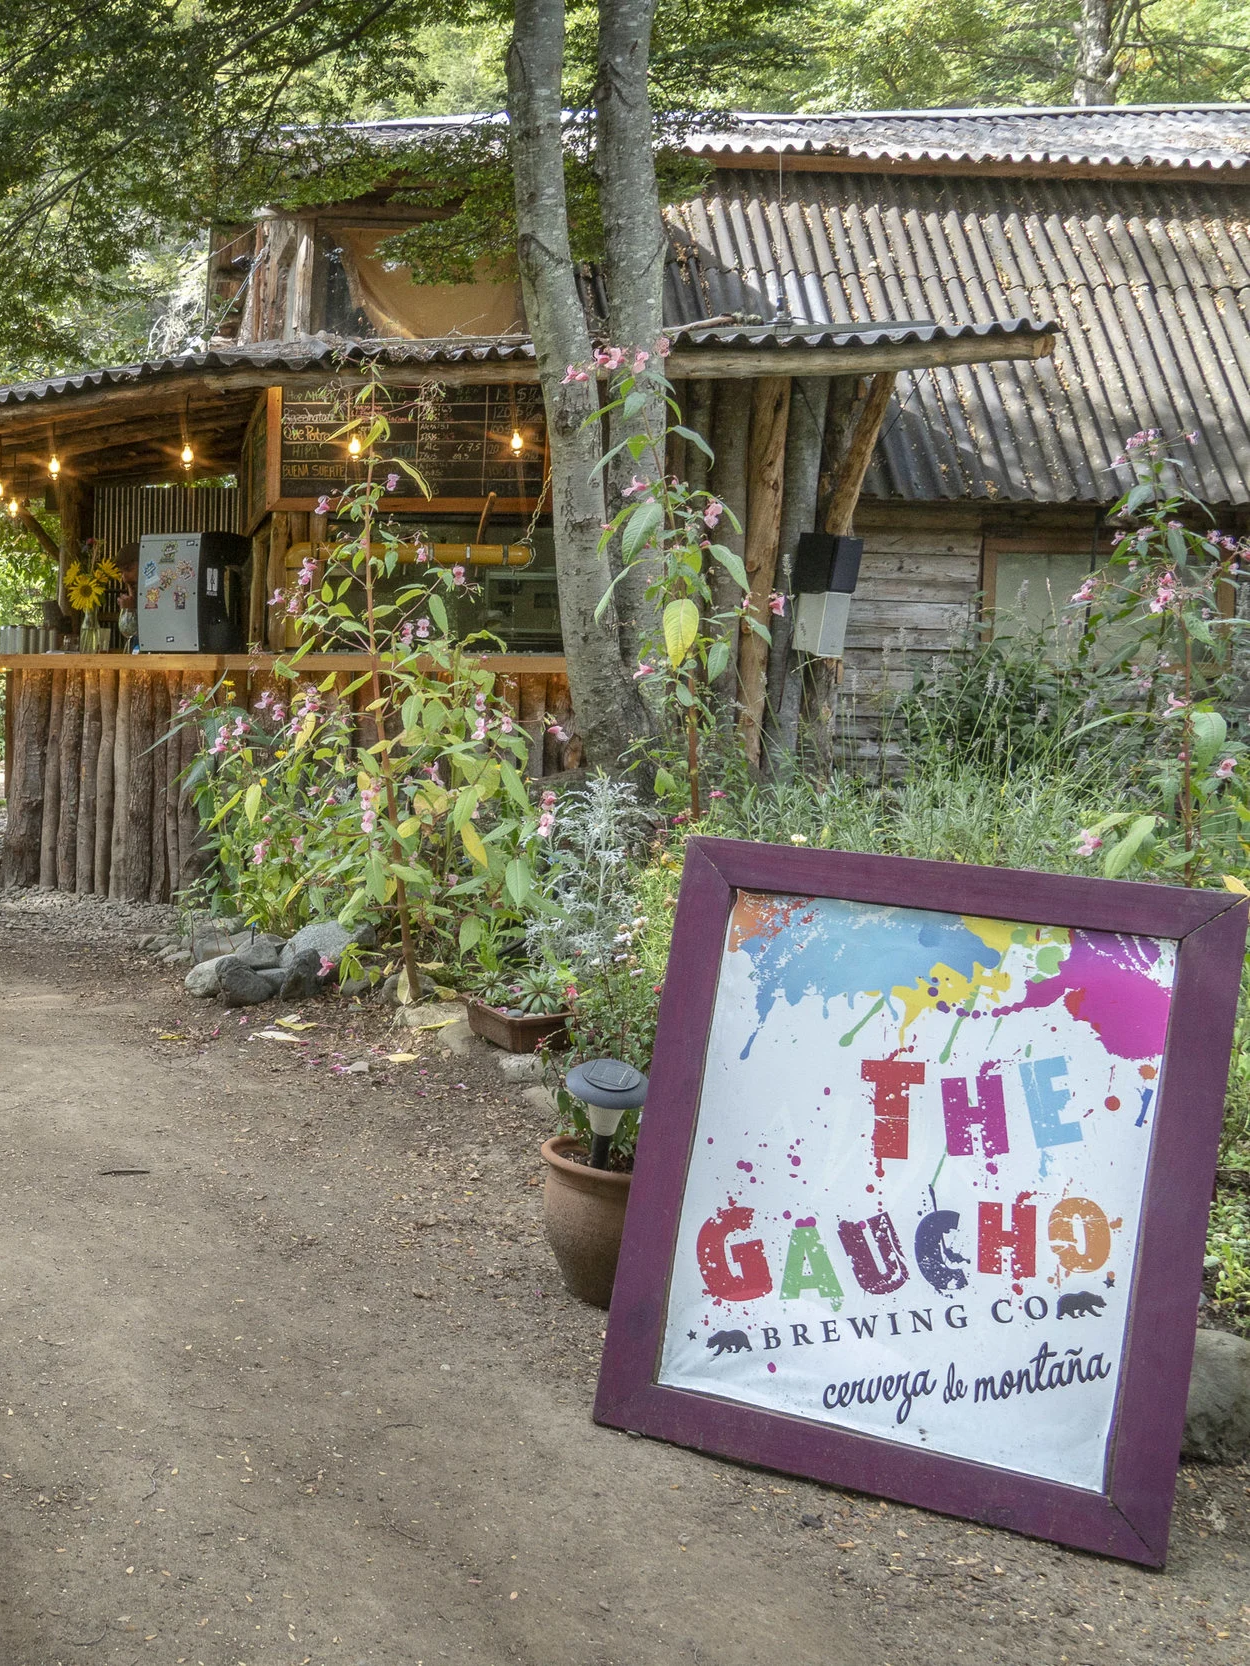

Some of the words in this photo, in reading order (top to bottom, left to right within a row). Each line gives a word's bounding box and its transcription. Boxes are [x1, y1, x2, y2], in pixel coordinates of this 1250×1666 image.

[311, 464, 346, 478] SUERTE
[861, 1056, 1083, 1160] THE
[696, 1197, 1112, 1302] GAUCHO
[761, 1304, 968, 1350] BREWING
[991, 1295, 1049, 1324] CO
[823, 1368, 937, 1424] cerveza
[943, 1362, 968, 1404] de
[974, 1342, 1112, 1403] montaña
